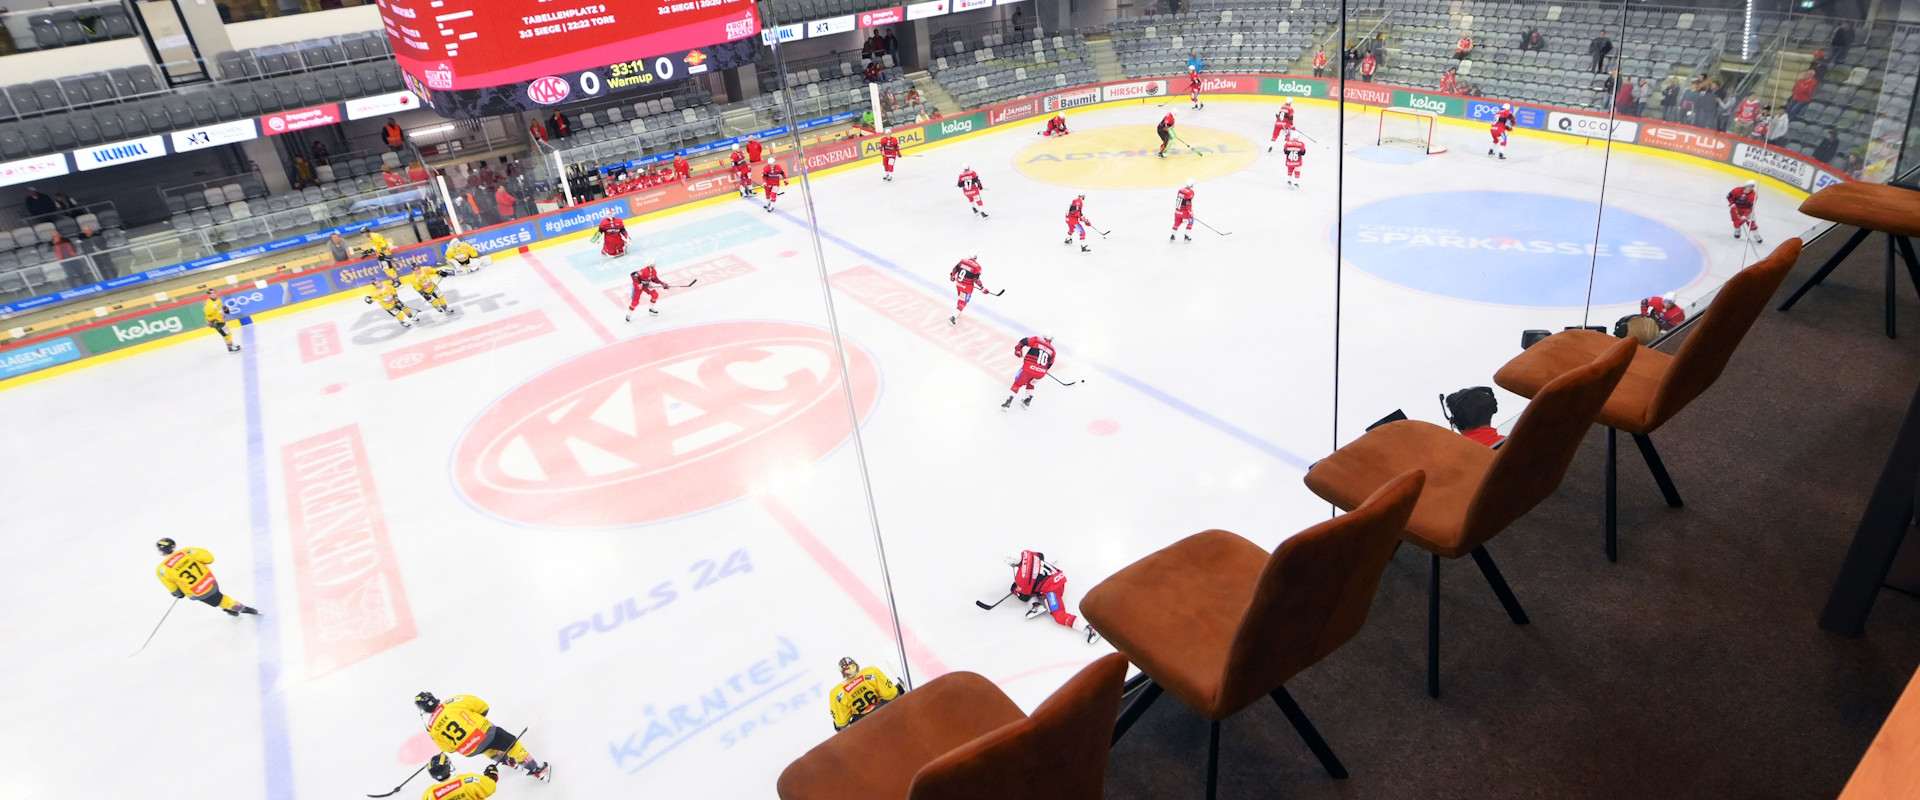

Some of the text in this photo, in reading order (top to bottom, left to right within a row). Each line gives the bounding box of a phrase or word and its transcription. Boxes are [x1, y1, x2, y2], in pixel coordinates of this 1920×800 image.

[522, 4, 606, 26] TABELLENPLATZ 9
[671, 2, 695, 12] SIEGE
[518, 29, 534, 39] 3:3
[534, 24, 562, 37] SIEGE
[567, 18, 590, 31] 22:22
[590, 15, 616, 27] TORE
[610, 59, 645, 77] 33:11
[655, 56, 674, 80] 0
[531, 77, 567, 103] KAC
[579, 71, 600, 95] 0
[606, 72, 654, 89] Warmup
[1110, 85, 1143, 97] HIRSCH
[1278, 80, 1312, 96] kelag
[1060, 94, 1097, 108] Baumit
[1343, 86, 1391, 105] GENERALI
[1409, 93, 1447, 112] kelag
[1006, 104, 1032, 116] JAMNIG
[941, 118, 973, 134] kelag
[1656, 127, 1717, 149] STW
[807, 146, 859, 169] GENERALI
[1288, 150, 1299, 161] 46
[1744, 152, 1797, 173] PRASSER
[1746, 146, 1798, 167] IMPEXA
[1356, 230, 1613, 257] SPARKASSE
[340, 265, 379, 284] Hirter
[959, 269, 967, 282] 9
[225, 292, 264, 314] go-e
[112, 316, 183, 343] kelag
[0, 341, 73, 369] LAGENFURT
[1036, 349, 1049, 367] 10
[503, 345, 832, 483] KAC
[294, 435, 381, 588] GENERALI
[179, 561, 204, 585] 37
[557, 547, 755, 653] PULS 24
[850, 685, 867, 699] STEEN
[852, 690, 878, 713] 26
[441, 720, 467, 746] 13
